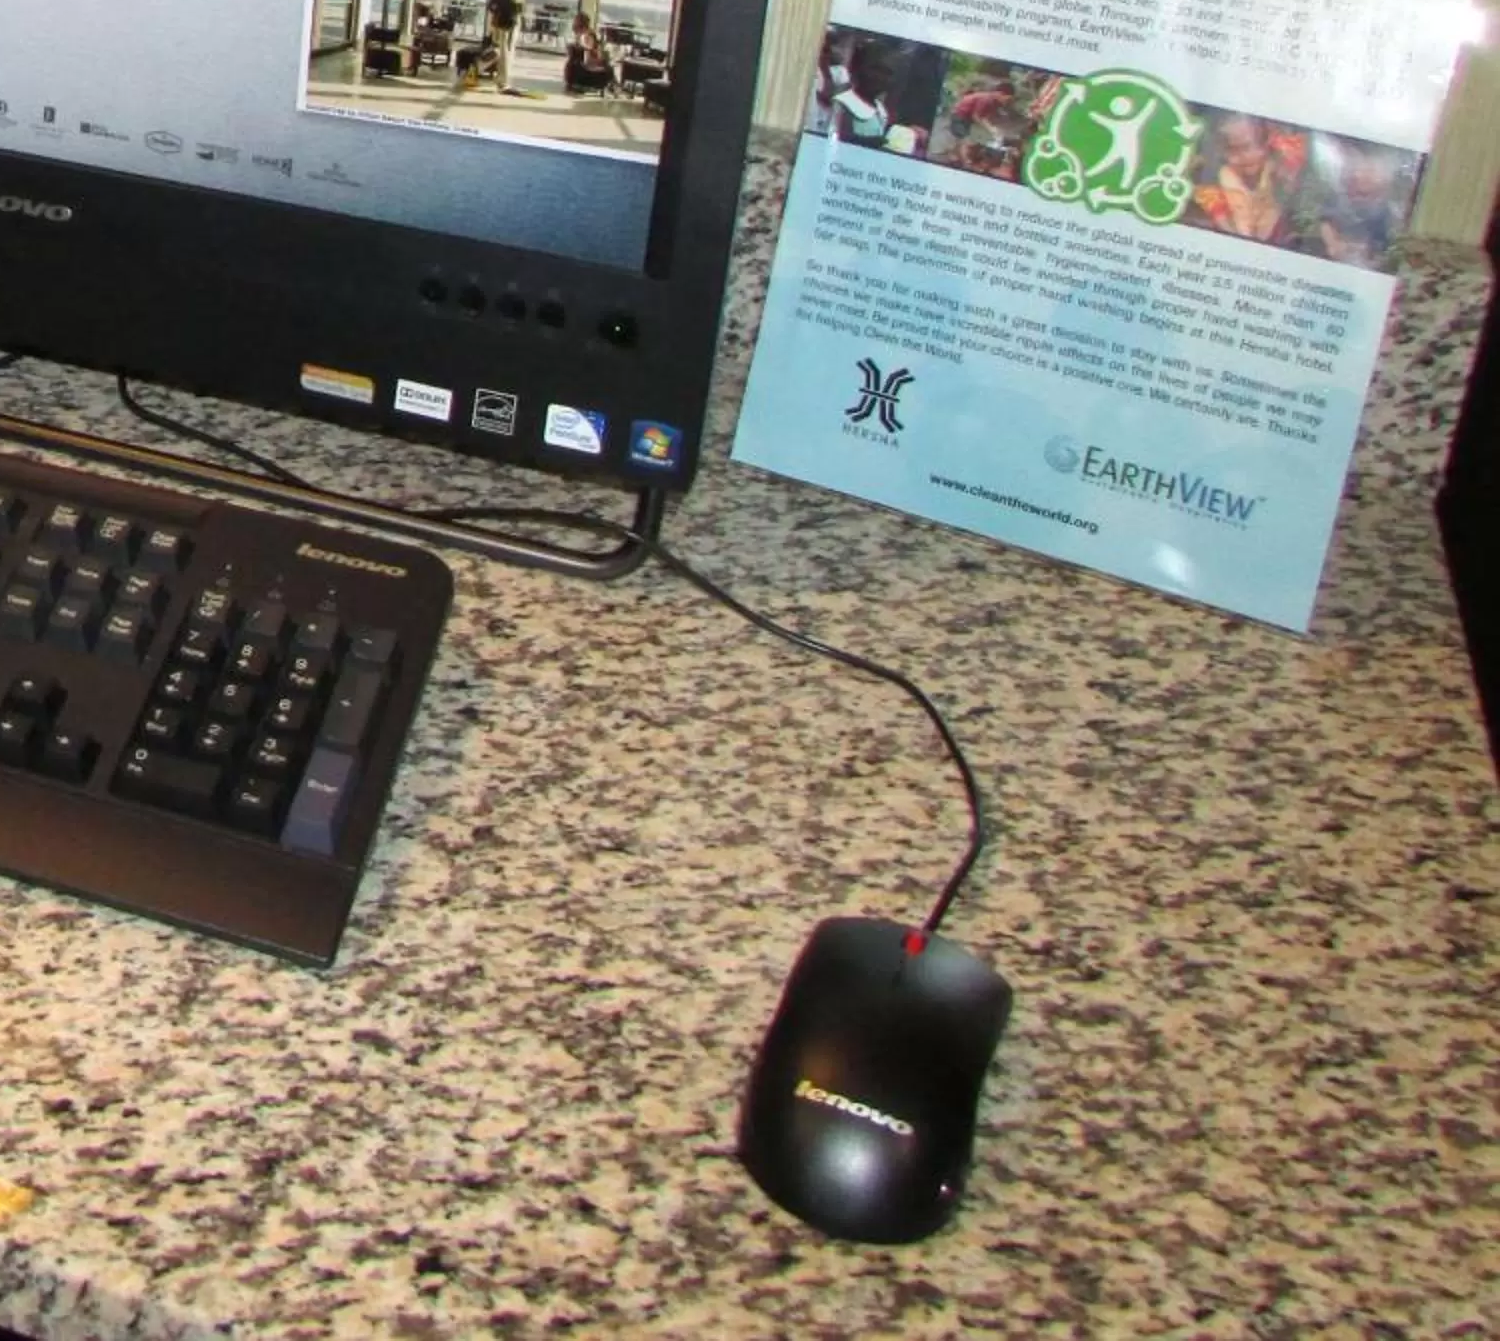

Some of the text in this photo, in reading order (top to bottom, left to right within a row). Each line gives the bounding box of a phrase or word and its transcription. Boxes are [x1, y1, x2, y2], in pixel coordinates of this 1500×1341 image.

[840, 421, 901, 449] HERSHA
[928, 471, 1100, 535] www.cleantheworld.org
[296, 542, 407, 578] lenovo
[794, 1080, 915, 1135] lenovo
